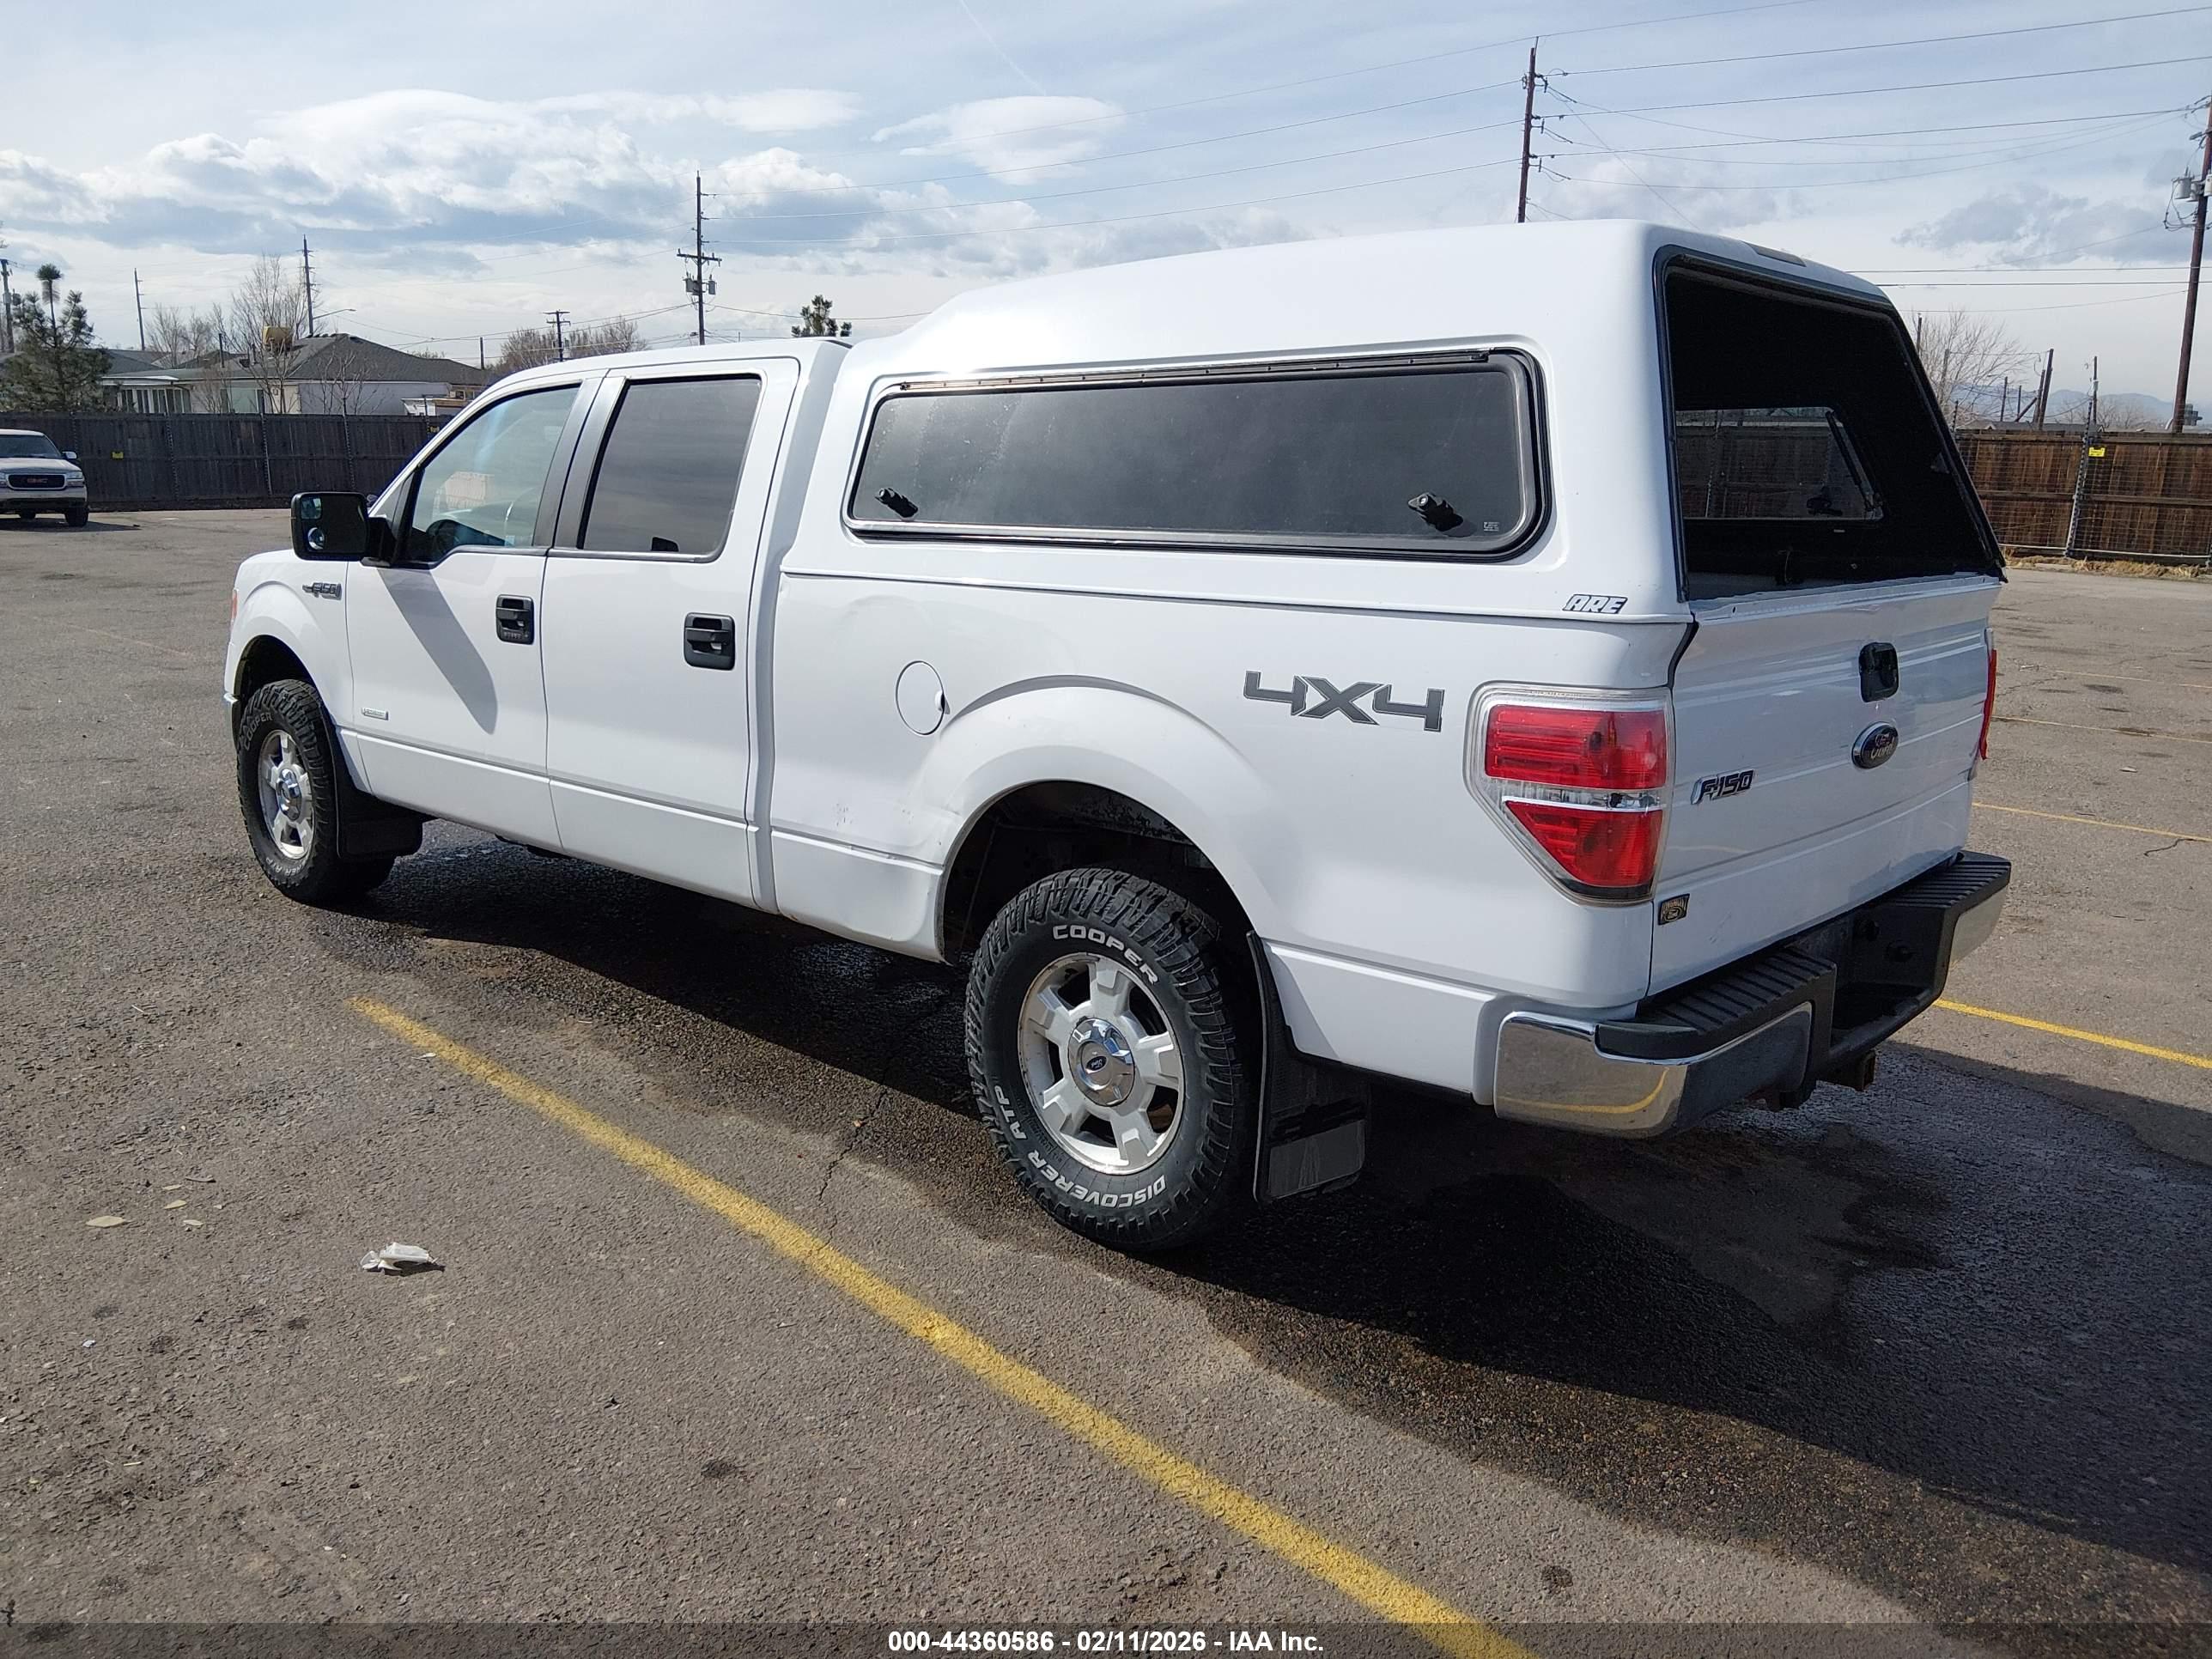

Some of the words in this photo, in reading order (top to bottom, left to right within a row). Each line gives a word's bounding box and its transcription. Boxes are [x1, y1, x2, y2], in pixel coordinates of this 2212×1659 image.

[1562, 594, 1628, 614] ARE
[244, 712, 274, 751] COOPER
[1052, 924, 1159, 985] COOPER
[994, 1085, 1028, 1140] ATP
[1027, 1149, 1168, 1209] DISCOVERER
